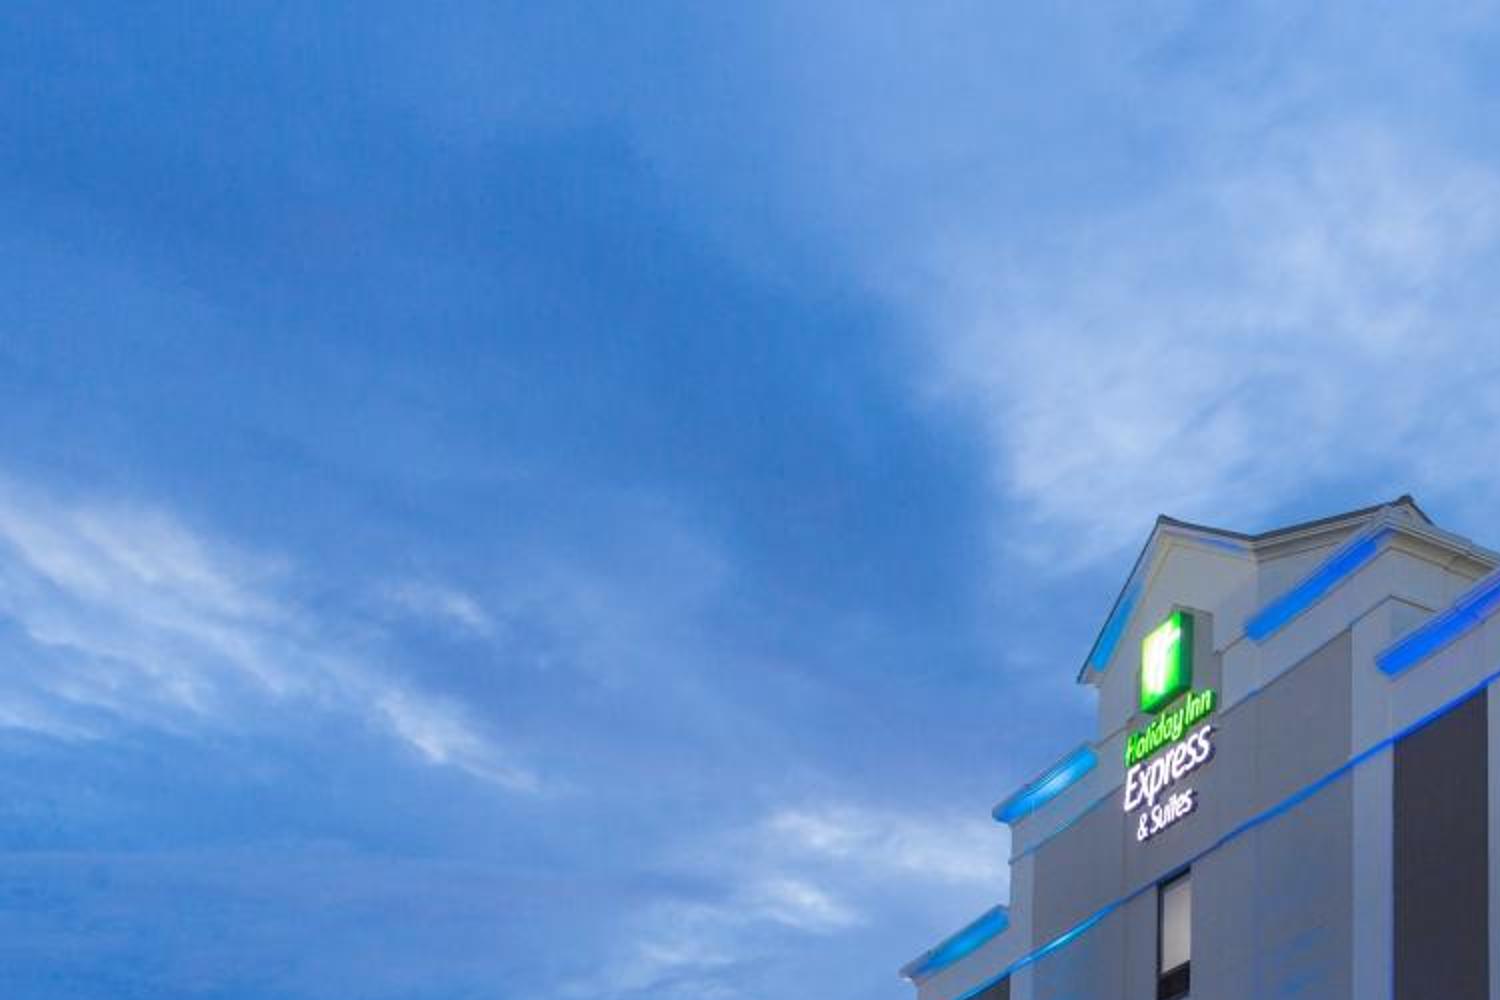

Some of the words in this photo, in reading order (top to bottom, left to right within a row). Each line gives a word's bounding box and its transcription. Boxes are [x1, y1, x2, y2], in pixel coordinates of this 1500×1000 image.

[1124, 710, 1184, 767] Holiday
[1184, 688, 1213, 725] Inn
[1124, 725, 1211, 811] Express
[1136, 813, 1149, 841] &
[1149, 789, 1194, 834] Suites
